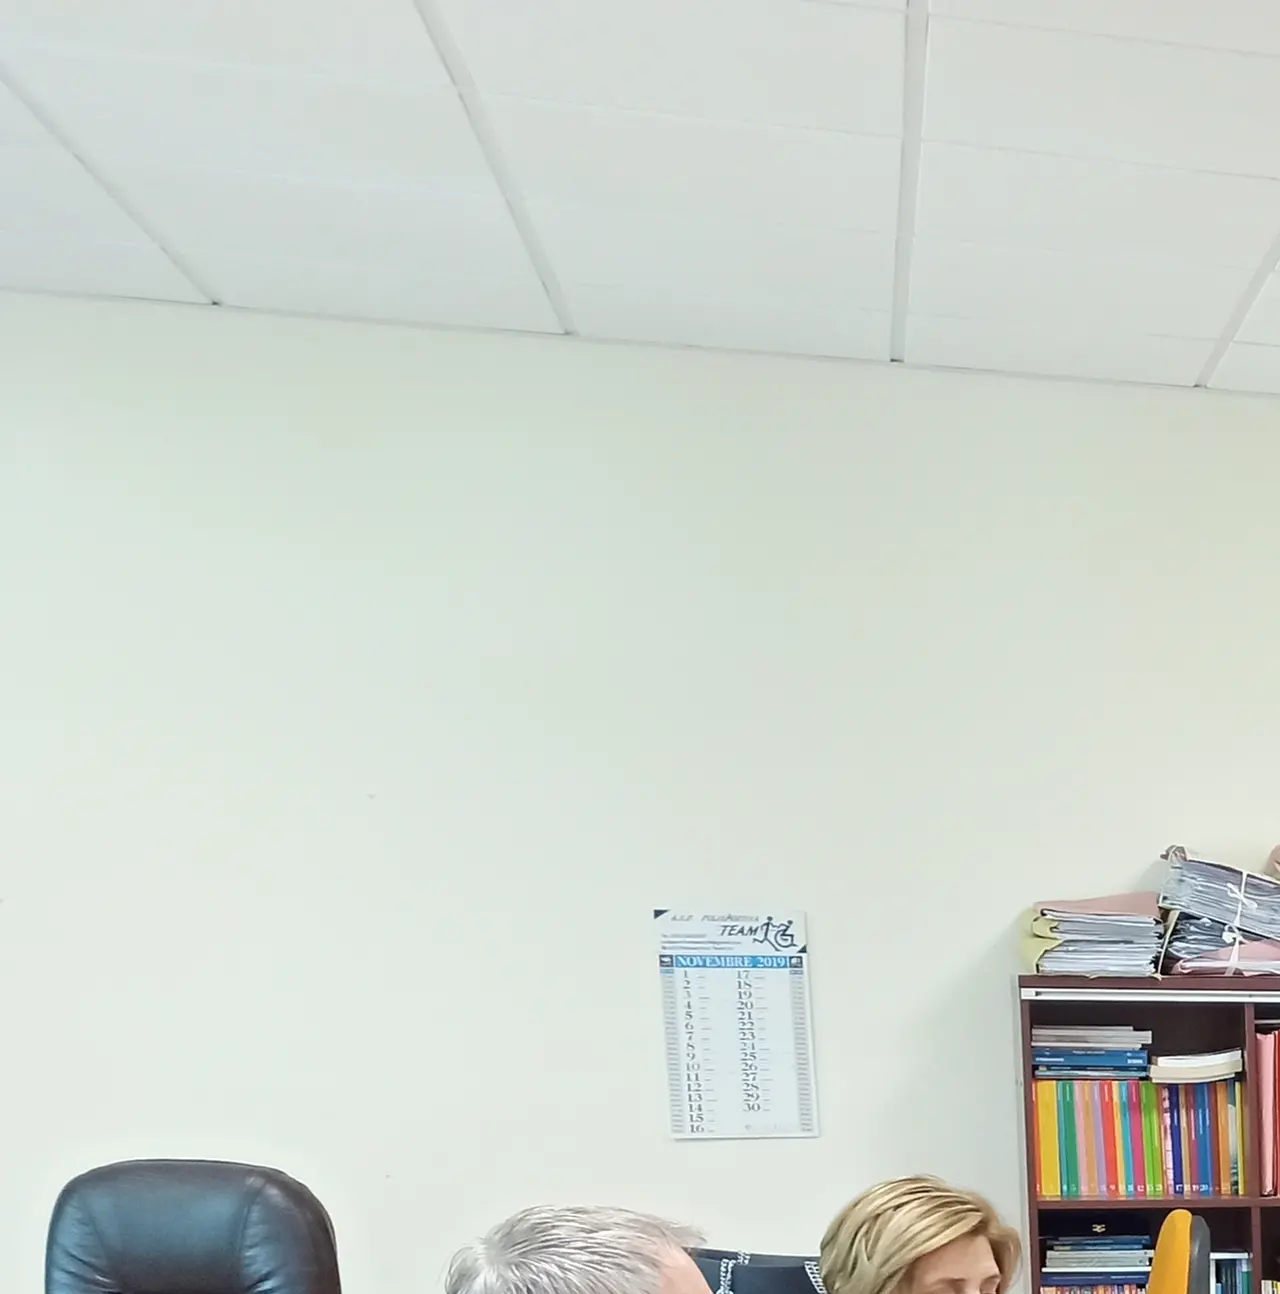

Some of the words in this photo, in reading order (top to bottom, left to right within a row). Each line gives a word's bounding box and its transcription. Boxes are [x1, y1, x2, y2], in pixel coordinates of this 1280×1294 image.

[720, 925, 759, 936] TEAM
[677, 955, 753, 968] NOVEMBRE
[757, 955, 786, 968] 2019
[683, 970, 688, 978] 1
[736, 970, 750, 979] 17
[683, 980, 691, 989] 2
[737, 980, 752, 989] 18
[738, 991, 752, 999] 19
[736, 1001, 754, 1010] 20
[685, 1011, 693, 1020] 5
[738, 1011, 753, 1020] 21
[685, 1022, 694, 1030] 6
[738, 1021, 754, 1030] 22
[739, 1031, 756, 1040] 23
[686, 1042, 695, 1050] 8
[686, 1052, 695, 1061] 9
[740, 1052, 757, 1061] 25
[686, 1062, 700, 1071] 10
[741, 1062, 758, 1071] 26
[687, 1073, 700, 1082] 11
[741, 1072, 758, 1081] 27
[687, 1083, 702, 1092] 12
[742, 1082, 759, 1091] 28
[688, 1093, 703, 1102] 13
[743, 1093, 760, 1102] 29
[689, 1104, 703, 1112] 14
[743, 1103, 761, 1112] 30
[689, 1114, 704, 1122] 15
[690, 1124, 705, 1133] 16
